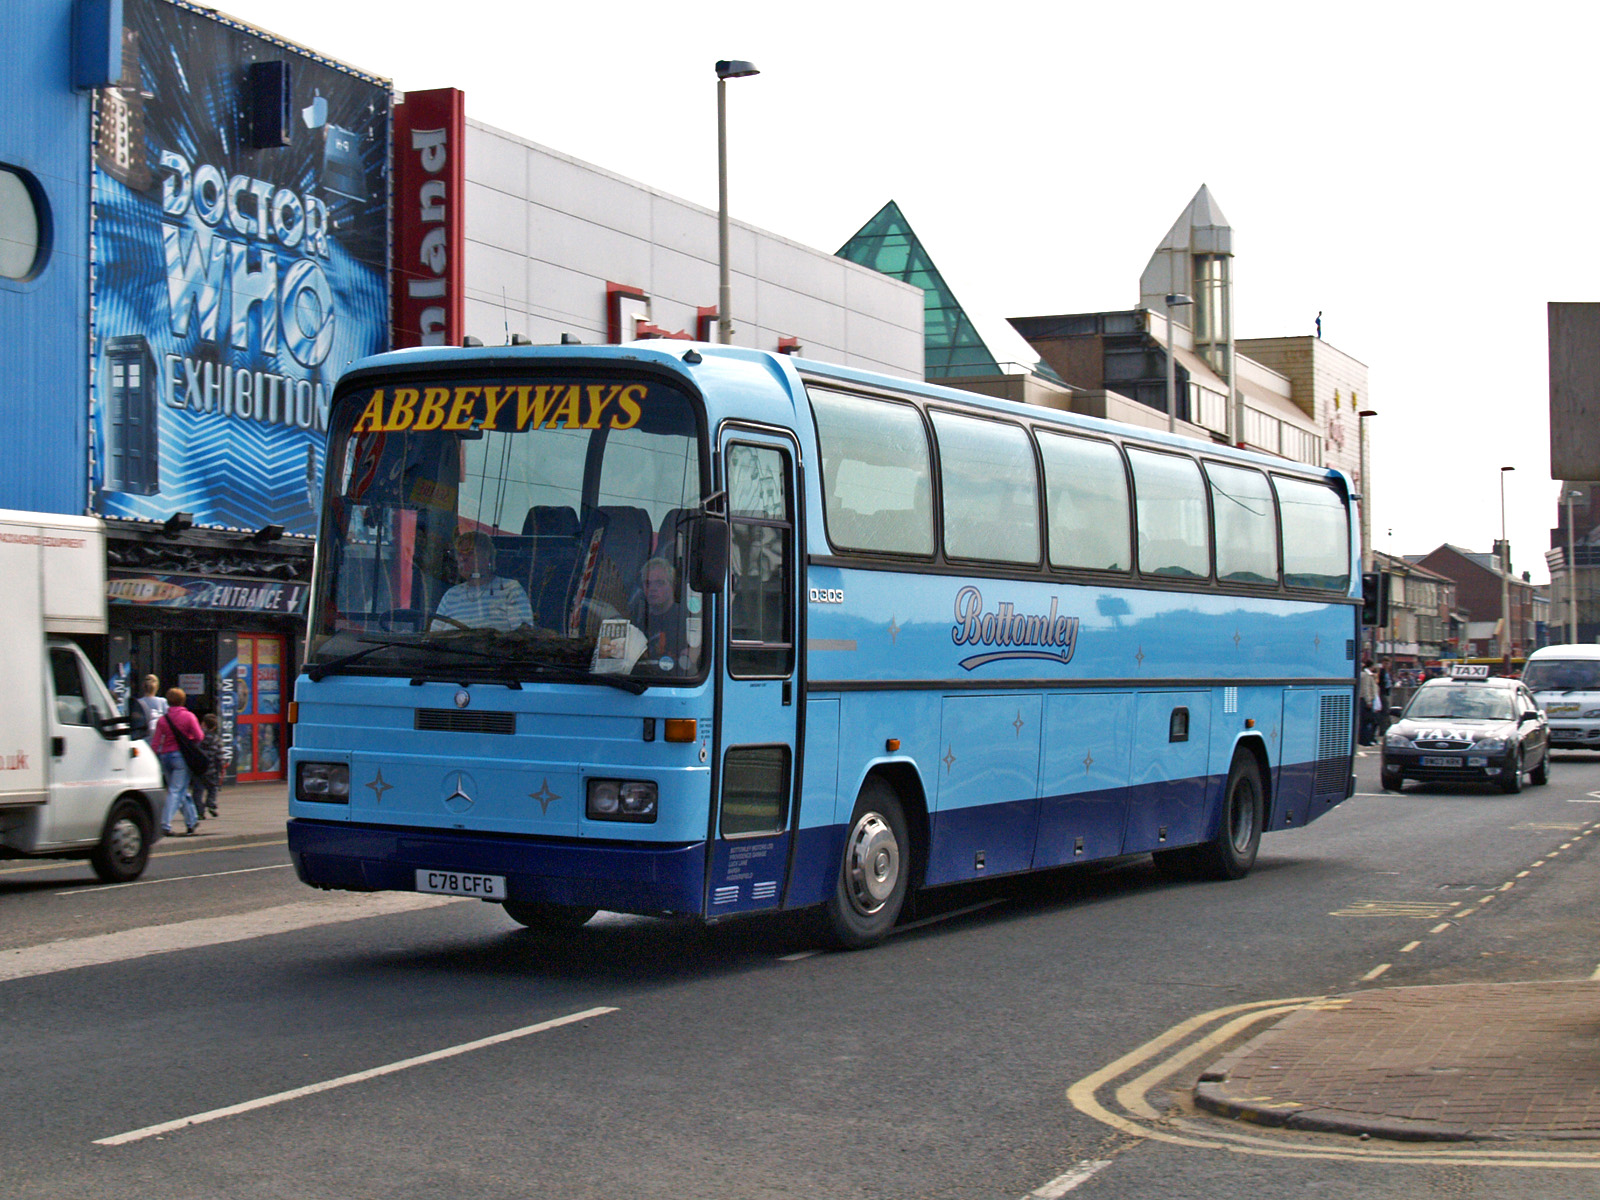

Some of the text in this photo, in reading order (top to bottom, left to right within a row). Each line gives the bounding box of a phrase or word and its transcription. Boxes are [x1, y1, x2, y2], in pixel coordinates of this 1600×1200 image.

[159, 149, 331, 261] DOCTOR
[161, 221, 336, 369] WHO
[165, 352, 331, 433] EXHIBITION
[352, 384, 648, 433] ABBEYWAYS
[210, 586, 284, 610] ENTRANCE
[951, 585, 1080, 669] Bottomley
[1455, 666, 1487, 676] TAXI
[221, 678, 234, 761] MUSEUM
[1413, 728, 1476, 742] TAXI
[428, 873, 493, 894] C78 CFG
